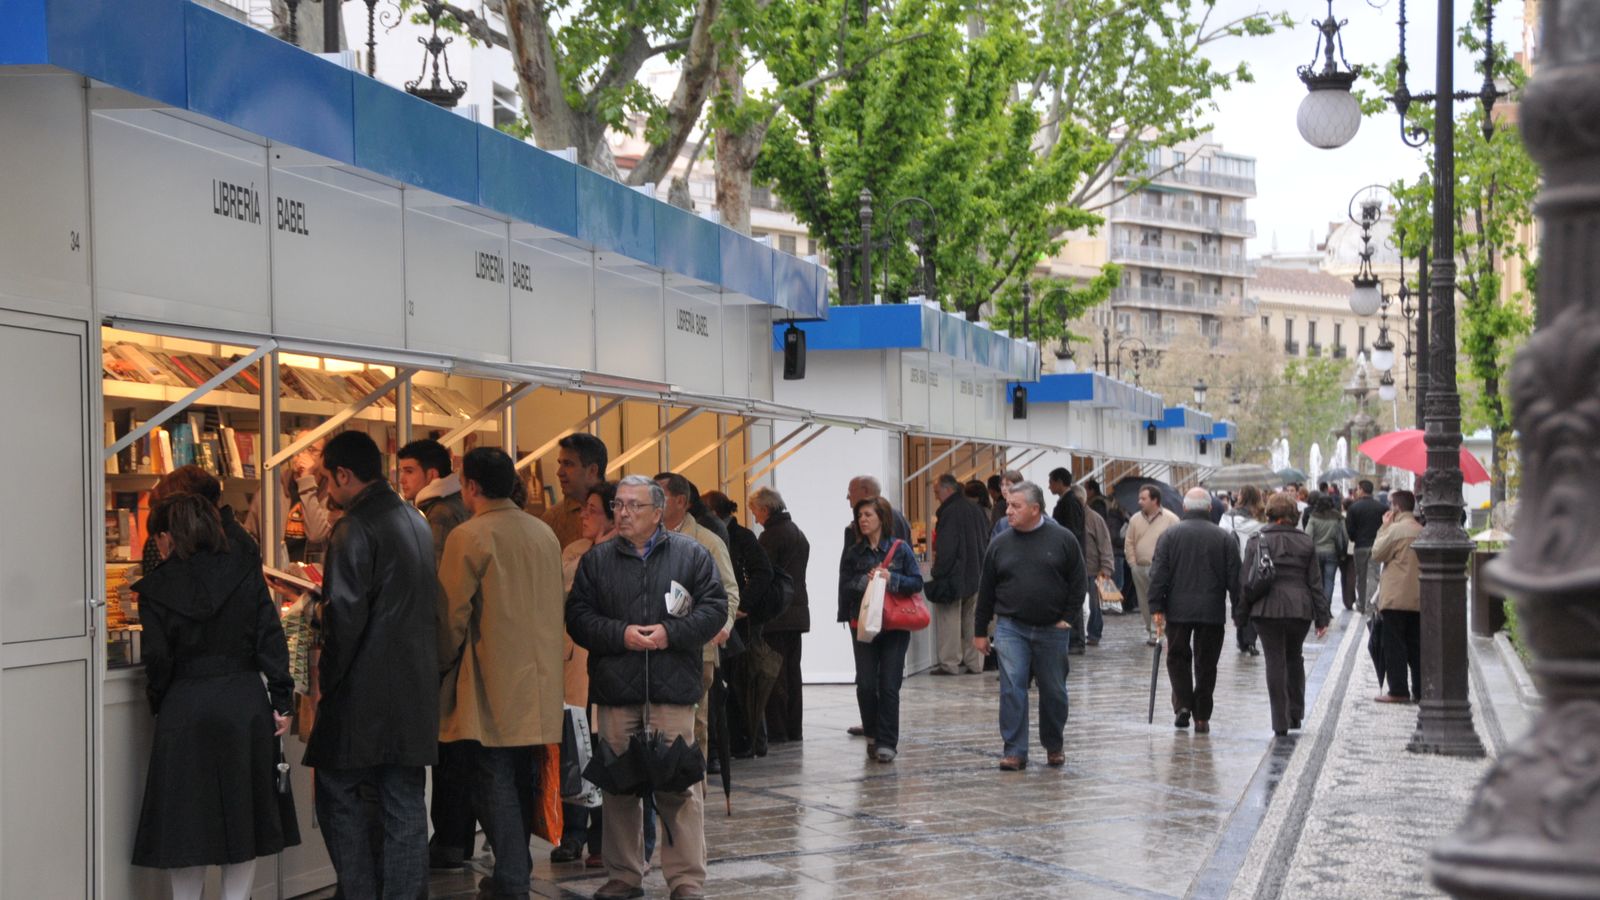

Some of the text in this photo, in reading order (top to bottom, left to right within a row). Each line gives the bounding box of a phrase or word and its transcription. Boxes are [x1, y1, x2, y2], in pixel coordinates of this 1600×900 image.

[212, 178, 309, 236] LIBRERÍA BABEL
[70, 230, 80, 252] 34
[475, 250, 533, 292] LIBRERÍA BABEL
[696, 313, 709, 337] BABEL
